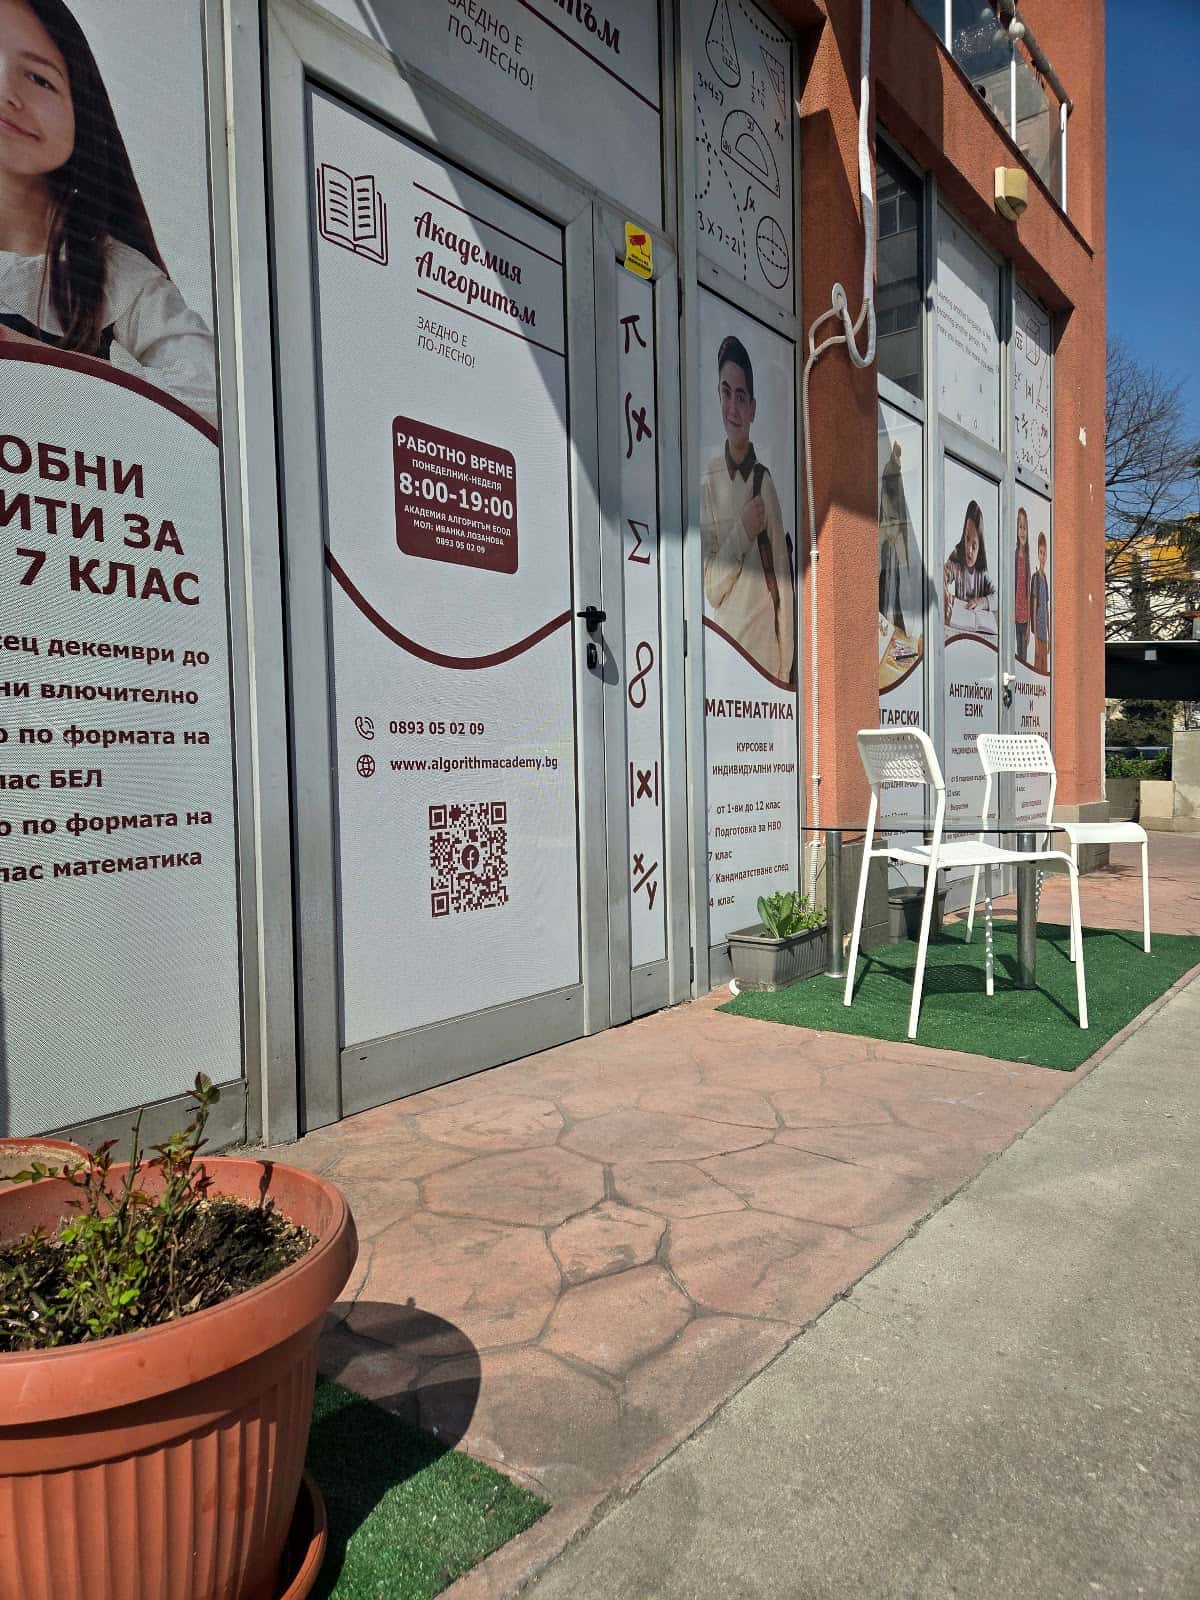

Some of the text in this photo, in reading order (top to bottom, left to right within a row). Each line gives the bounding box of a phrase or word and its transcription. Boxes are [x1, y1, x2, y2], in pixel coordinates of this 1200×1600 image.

[553, 0, 621, 53] тъм
[448, 14, 534, 90] ПО-ЛЕСНО!
[515, 35, 523, 55] Е
[414, 211, 522, 285] Академия
[415, 251, 536, 327] Алгоритъм
[416, 316, 468, 348] ЗАЕДНО Е
[416, 335, 476, 369] ПО-ЛЕСНО!
[0, 434, 145, 499] ОБНИ
[397, 432, 513, 479] РАБОТНО ВРЕМЕ
[412, 458, 502, 491] ПОНЕДЕЛНИК-НЕДЕЛЯ
[399, 472, 513, 520] 8:00-19:00
[0, 488, 185, 556] ИТИ ЗА
[404, 504, 446, 521] АКАДЕМИЯ
[492, 525, 511, 537] ЕООД
[413, 519, 504, 546] МОЛ: ИВАНКА ЛОЗАНОВА
[435, 536, 454, 549] 0893
[455, 540, 465, 550] 05
[466, 543, 475, 552] 02
[16, 548, 201, 606] 7 КЛАС
[0, 635, 210, 667] ец декември до
[40, 683, 199, 705] влючително
[949, 682, 993, 701] АНГЛИЙСКИ
[705, 697, 794, 721] МАТЕМАТИКА
[880, 708, 920, 726] ГАРСКИ
[964, 703, 984, 718] ЕЗИК
[19, 727, 53, 744] по
[62, 724, 176, 749] формата
[183, 730, 211, 745] на
[389, 720, 485, 736] 0893 05 02 09
[736, 741, 768, 753] КУРСОВЕ
[390, 756, 558, 773] www.algorithmacademy.bg
[712, 763, 795, 777] ИНДИВИДУАЛНИ УРОЦИ
[50, 769, 103, 789] БЕЛ
[716, 805, 726, 815] от
[744, 803, 754, 813] до
[755, 800, 765, 812] 12
[765, 800, 781, 811] клас
[22, 818, 57, 835] по
[66, 813, 178, 837] формата
[186, 810, 213, 826] на
[715, 820, 782, 838] Подготовка за НВО
[53, 851, 202, 878] математика
[715, 849, 733, 862] клас
[715, 866, 773, 883] Кандидатстване
[717, 894, 735, 907] клас
